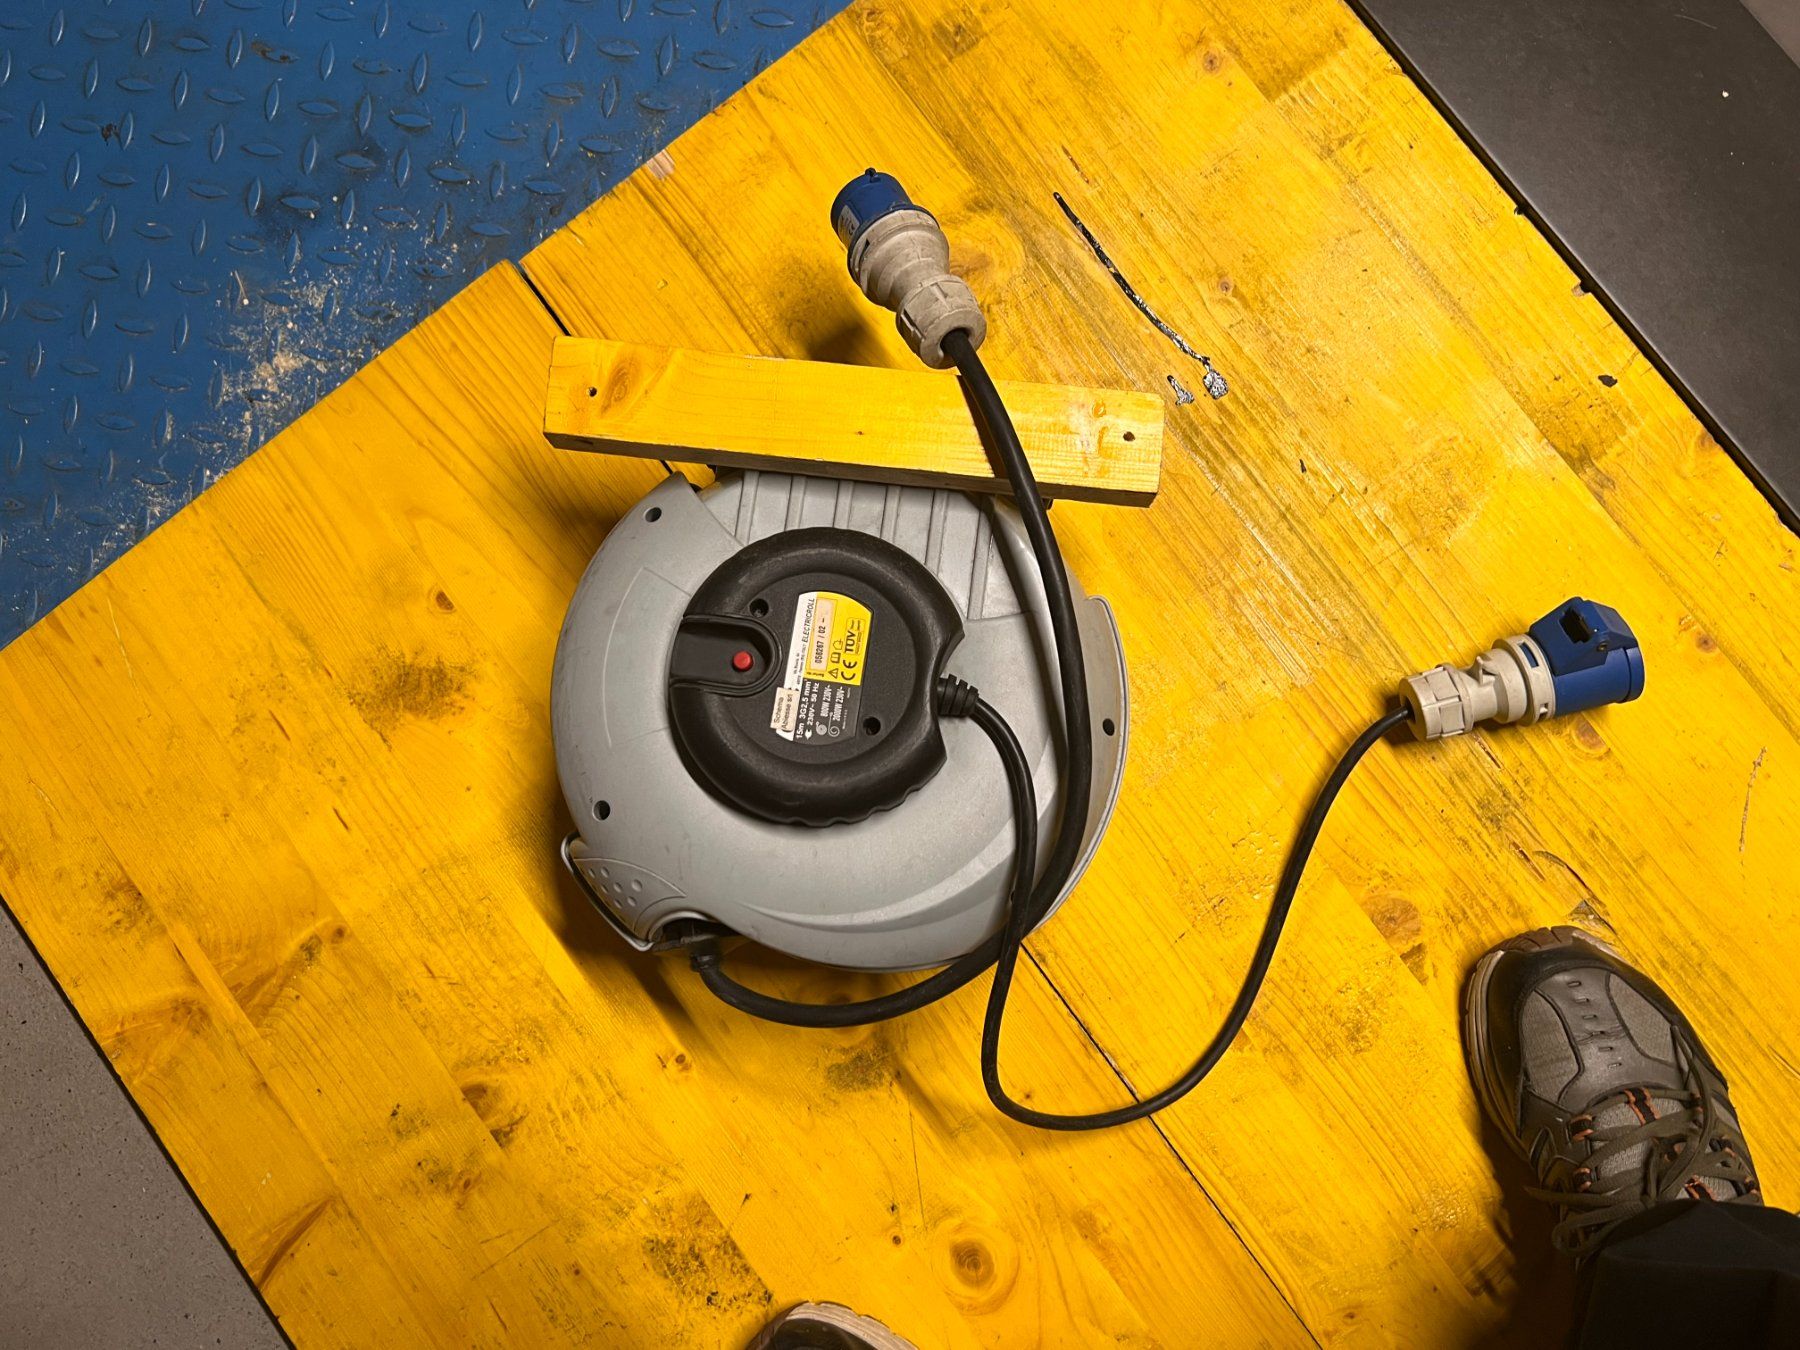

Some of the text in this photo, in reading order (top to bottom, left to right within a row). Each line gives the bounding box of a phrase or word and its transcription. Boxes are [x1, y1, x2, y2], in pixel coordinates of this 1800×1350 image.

[802, 598, 814, 643] ELECTRICROLL
[812, 682, 819, 693] Hz
[811, 693, 818, 702] 50
[799, 697, 809, 719] 3G2,5
[796, 723, 804, 739] 15m
